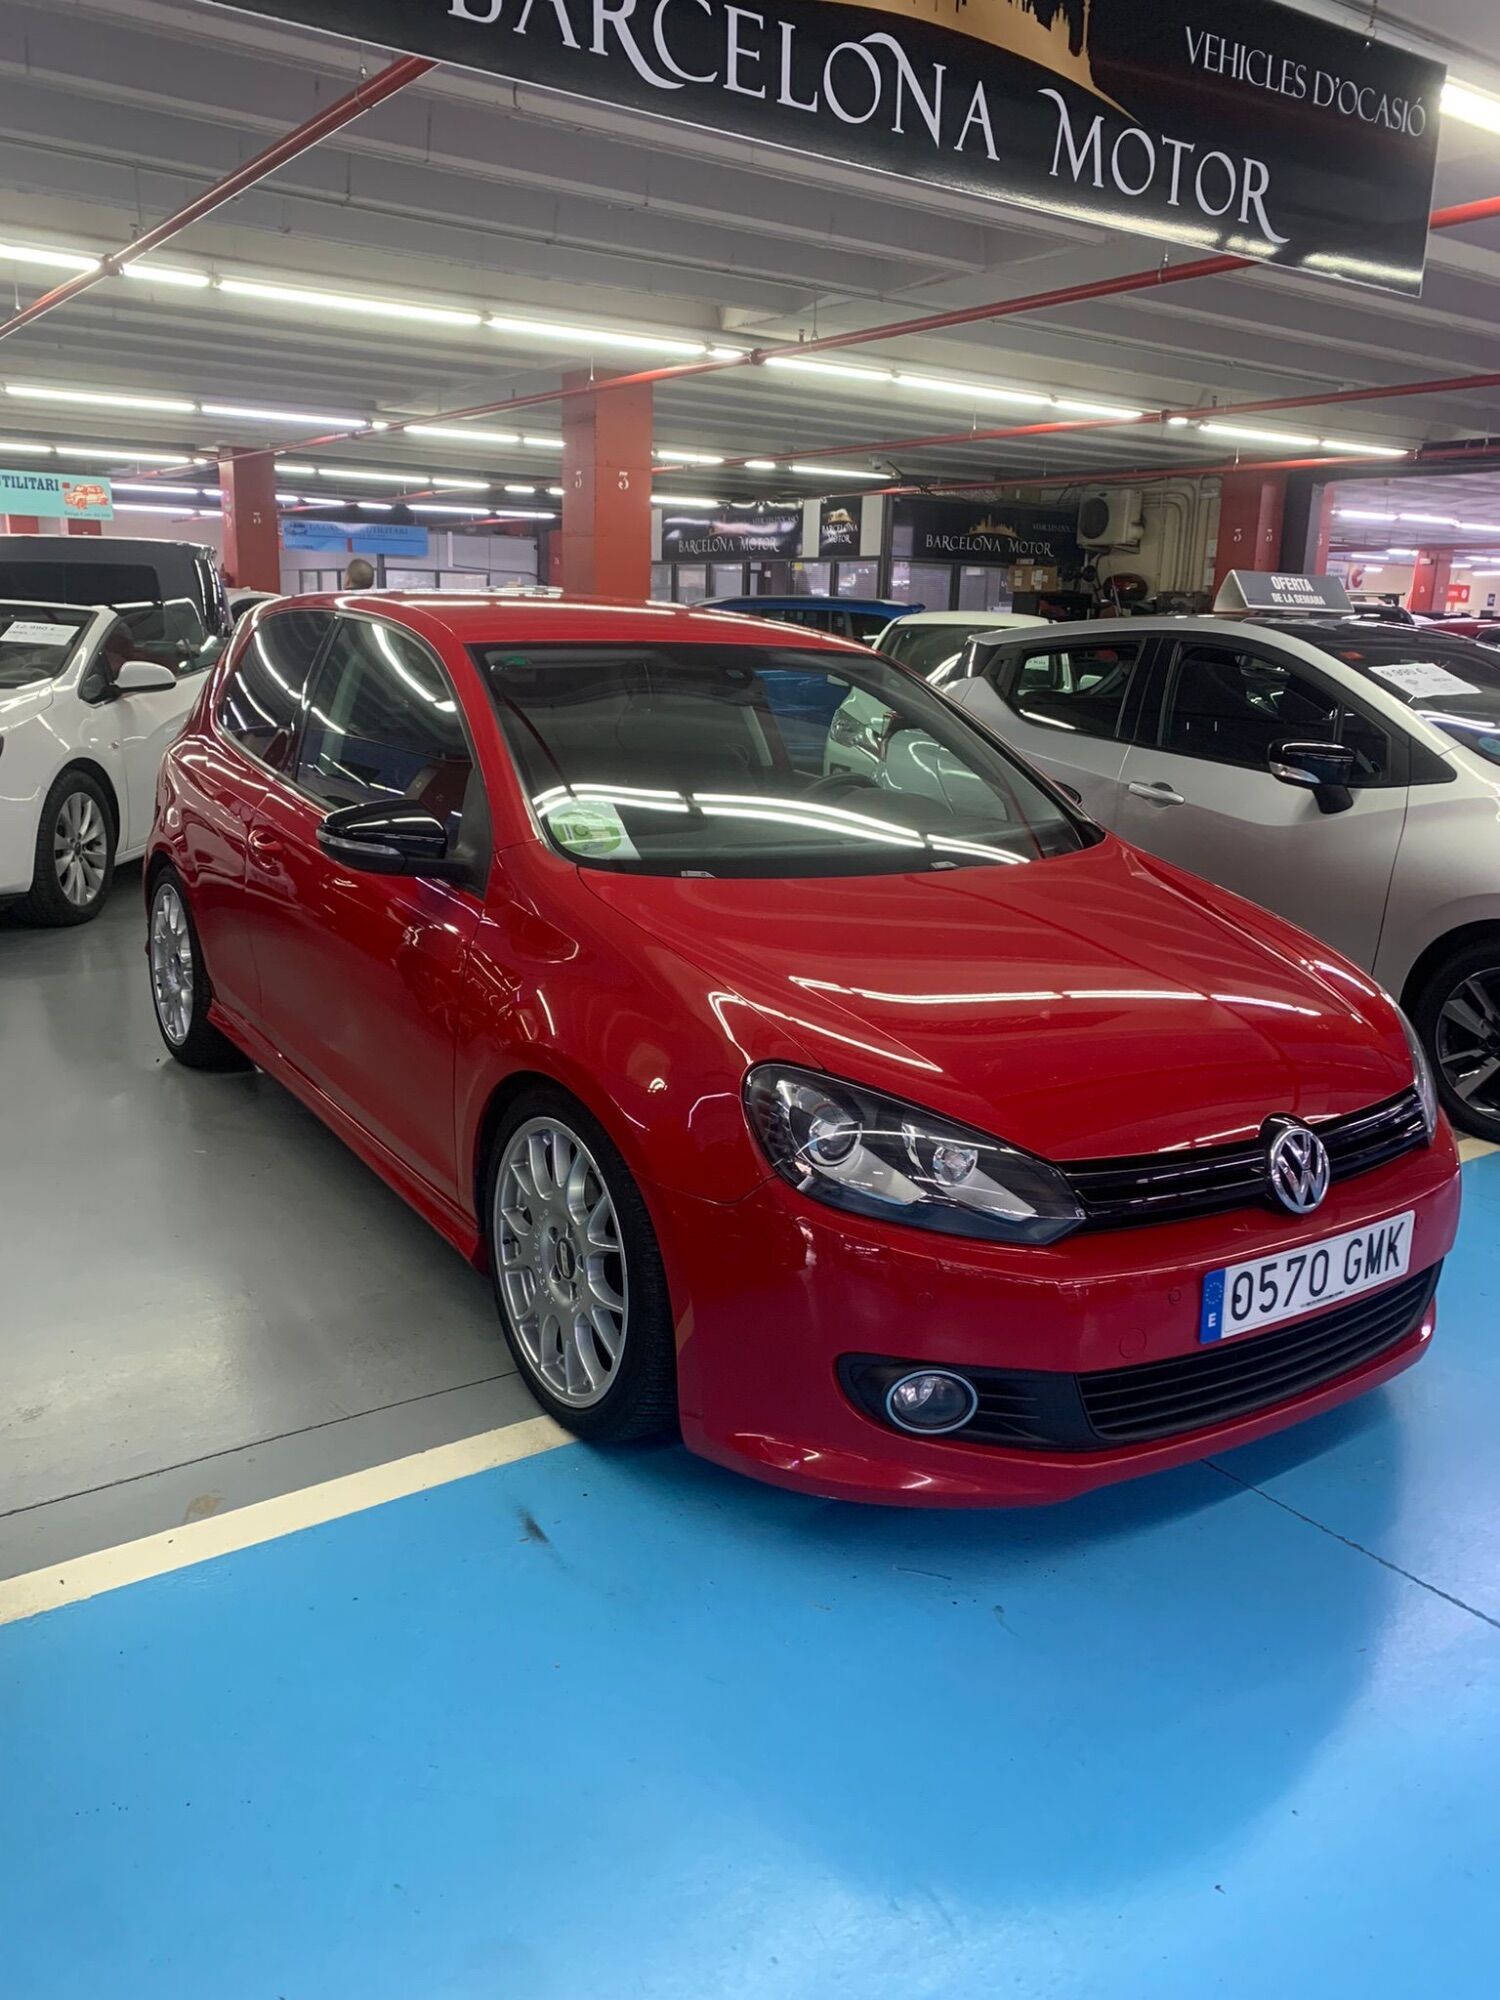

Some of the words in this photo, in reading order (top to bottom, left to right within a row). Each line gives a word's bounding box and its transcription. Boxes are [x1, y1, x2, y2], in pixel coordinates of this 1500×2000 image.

[1185, 26, 1308, 98] VEHICLES
[1313, 70, 1427, 137] D'OCASIÓ
[447, 0, 1000, 161] RCELONA
[1037, 88, 1291, 243] MOTOR
[0, 474, 60, 491] TILITARI
[821, 522, 859, 536] BARCELONA
[678, 536, 735, 554] BARCELONA
[738, 536, 781, 552] MOTOR
[826, 532, 852, 544] MOTOR
[926, 534, 1000, 552] BARCELONA
[1008, 538, 1055, 558] MOTOR
[1271, 576, 1314, 592] OFERTA
[1271, 593, 1283, 603] DE
[1282, 594, 1295, 603] LA
[1231, 1250, 1329, 1321] 0570
[1343, 1221, 1405, 1285] GMK
[1208, 1312, 1217, 1328] E
